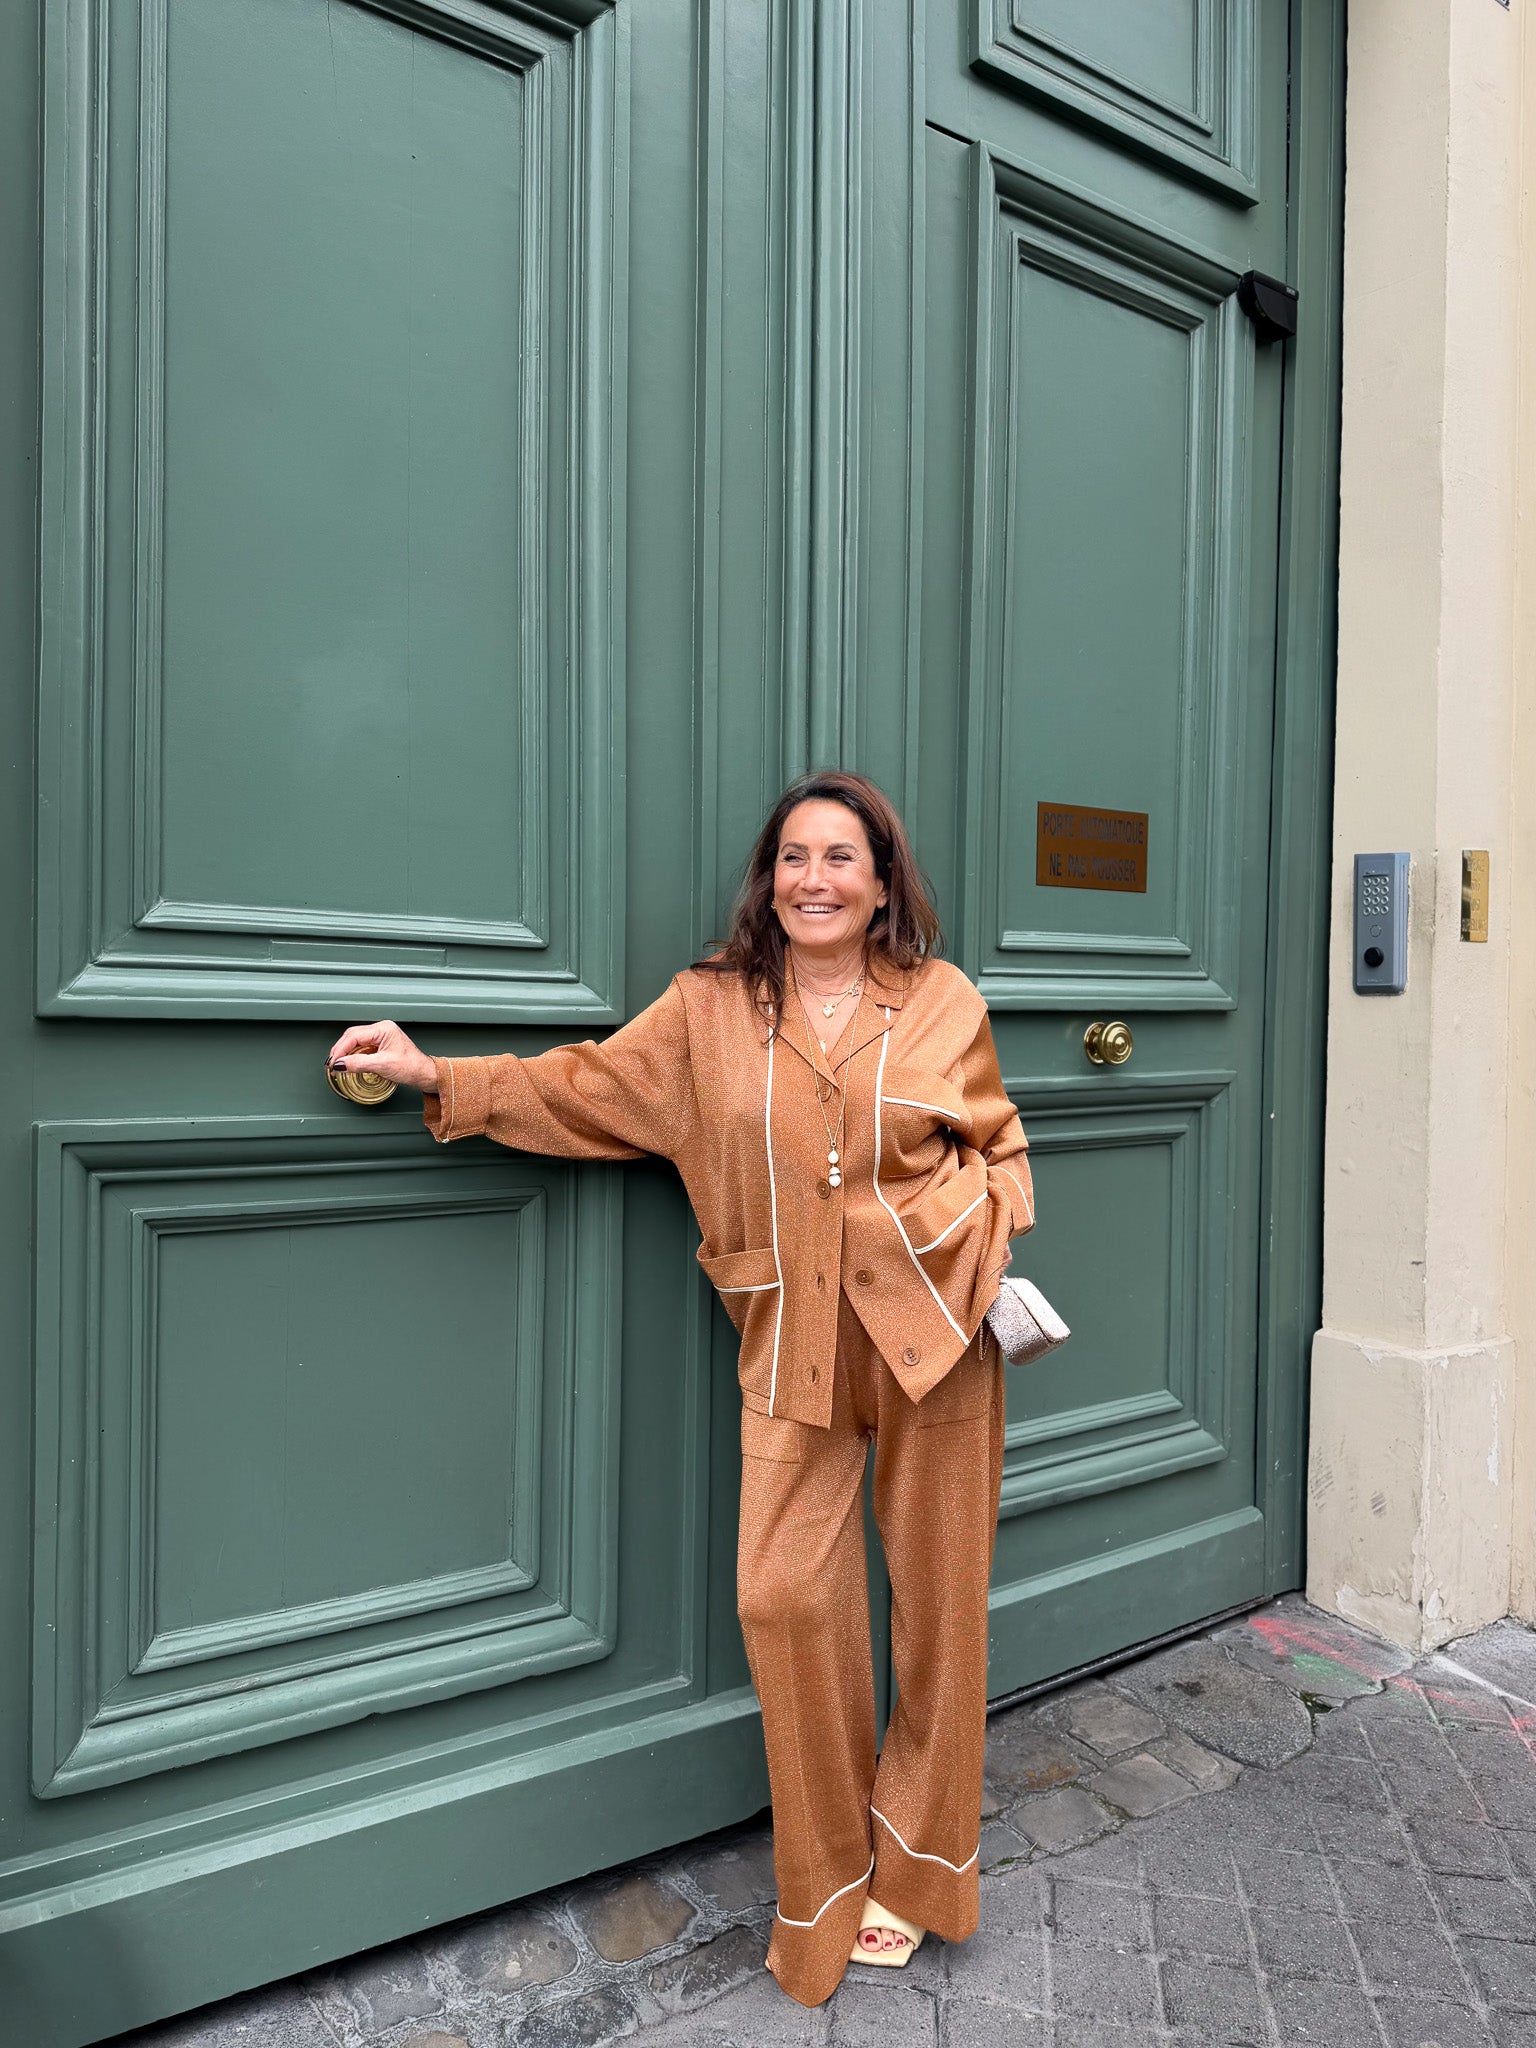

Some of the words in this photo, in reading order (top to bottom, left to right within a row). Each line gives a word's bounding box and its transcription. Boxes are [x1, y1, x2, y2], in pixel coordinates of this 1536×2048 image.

[1043, 812, 1074, 838] PORTE
[1080, 816, 1144, 845] AUTOMATIQUE
[1049, 853, 1062, 877] NE
[1068, 854, 1087, 879] PAS
[1091, 857, 1136, 882] POUSSER
